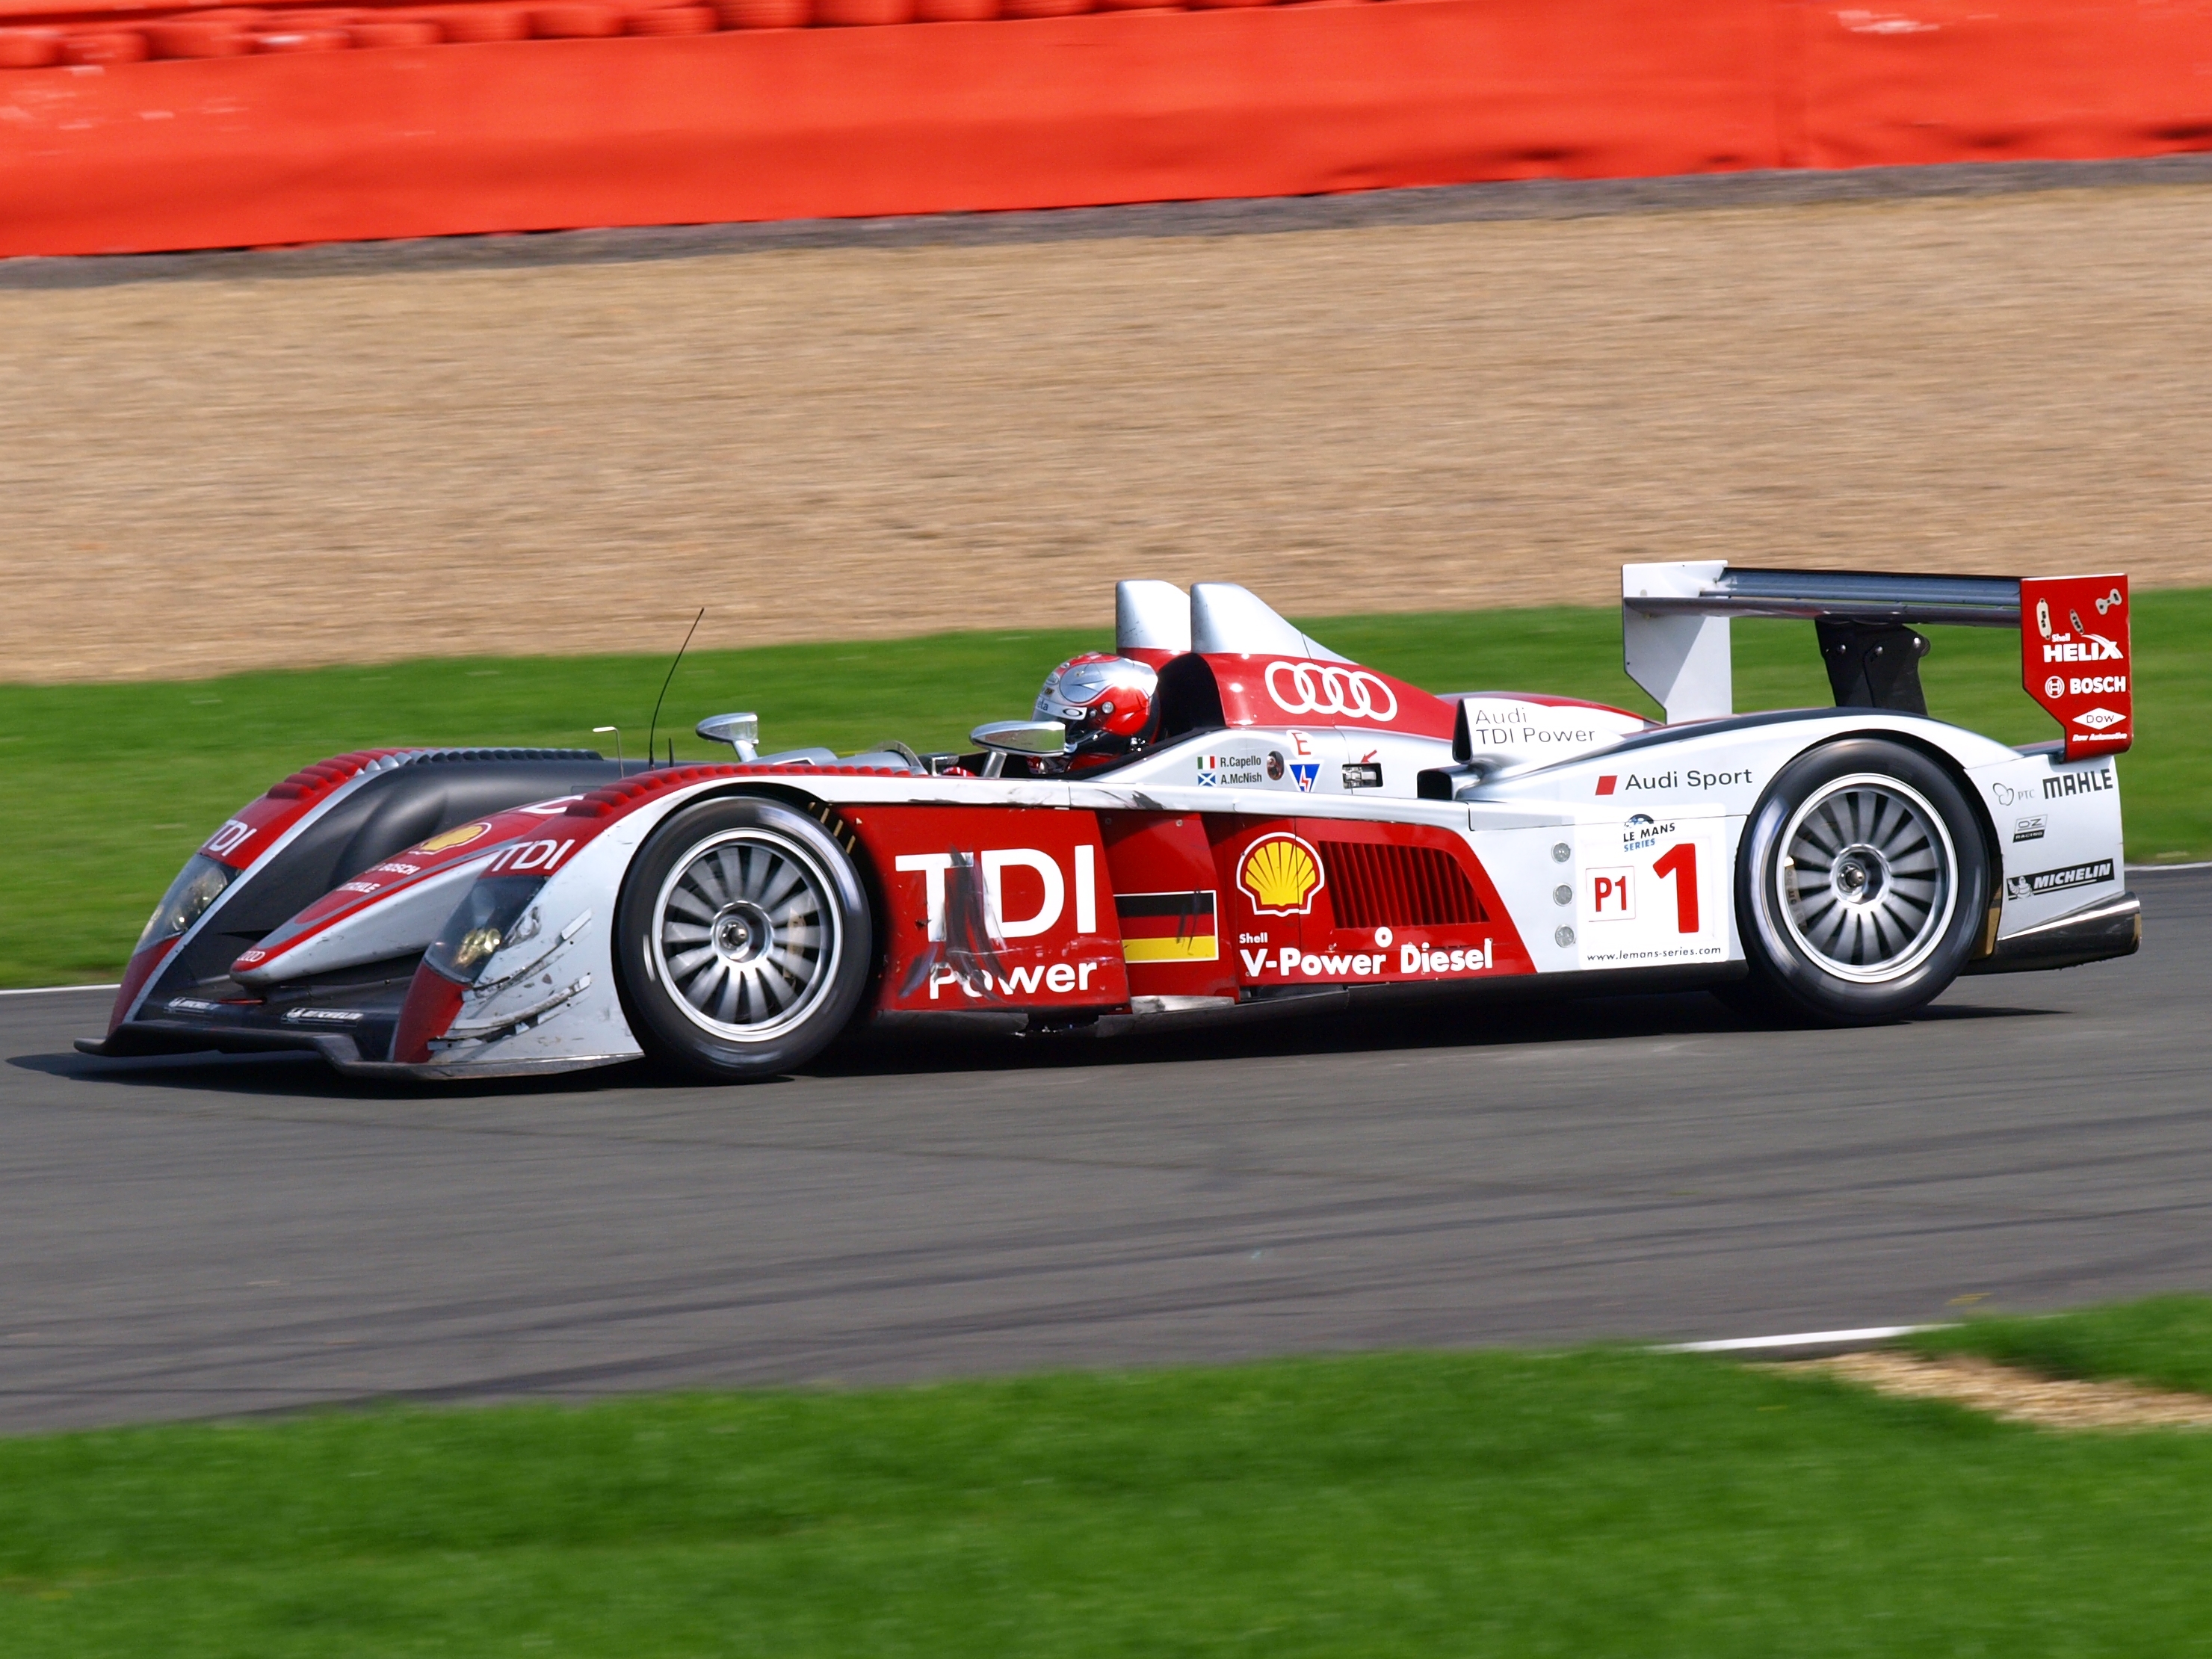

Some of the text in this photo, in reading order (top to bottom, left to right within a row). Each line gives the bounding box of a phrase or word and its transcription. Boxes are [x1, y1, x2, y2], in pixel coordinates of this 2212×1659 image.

[2043, 634, 2124, 663] HELIX
[2070, 676, 2126, 694] BOSCH
[1476, 708, 1527, 724] Audi
[1291, 732, 1311, 756] E
[1476, 727, 1595, 744] TDI Power
[1220, 756, 1261, 768] R.Capello
[1221, 773, 1262, 785] A.McNish
[1625, 769, 1753, 791] Audi Sport
[2042, 768, 2113, 800] MAHLE
[2018, 789, 2036, 800] PTC
[1623, 823, 1675, 842] LE MANS
[2018, 818, 2042, 829] OZ
[1624, 838, 1656, 852] SERIES
[492, 839, 575, 872] TDI
[2033, 863, 2112, 889] MICHELIN
[895, 844, 1096, 942] TDI
[1595, 876, 1627, 912] P1
[1652, 843, 1699, 933] 1
[1239, 932, 1268, 944] Shell
[1240, 939, 1493, 977] V-Power Diesel
[1587, 946, 1721, 962] www.lemans-series.com
[929, 961, 1098, 1000] Power
